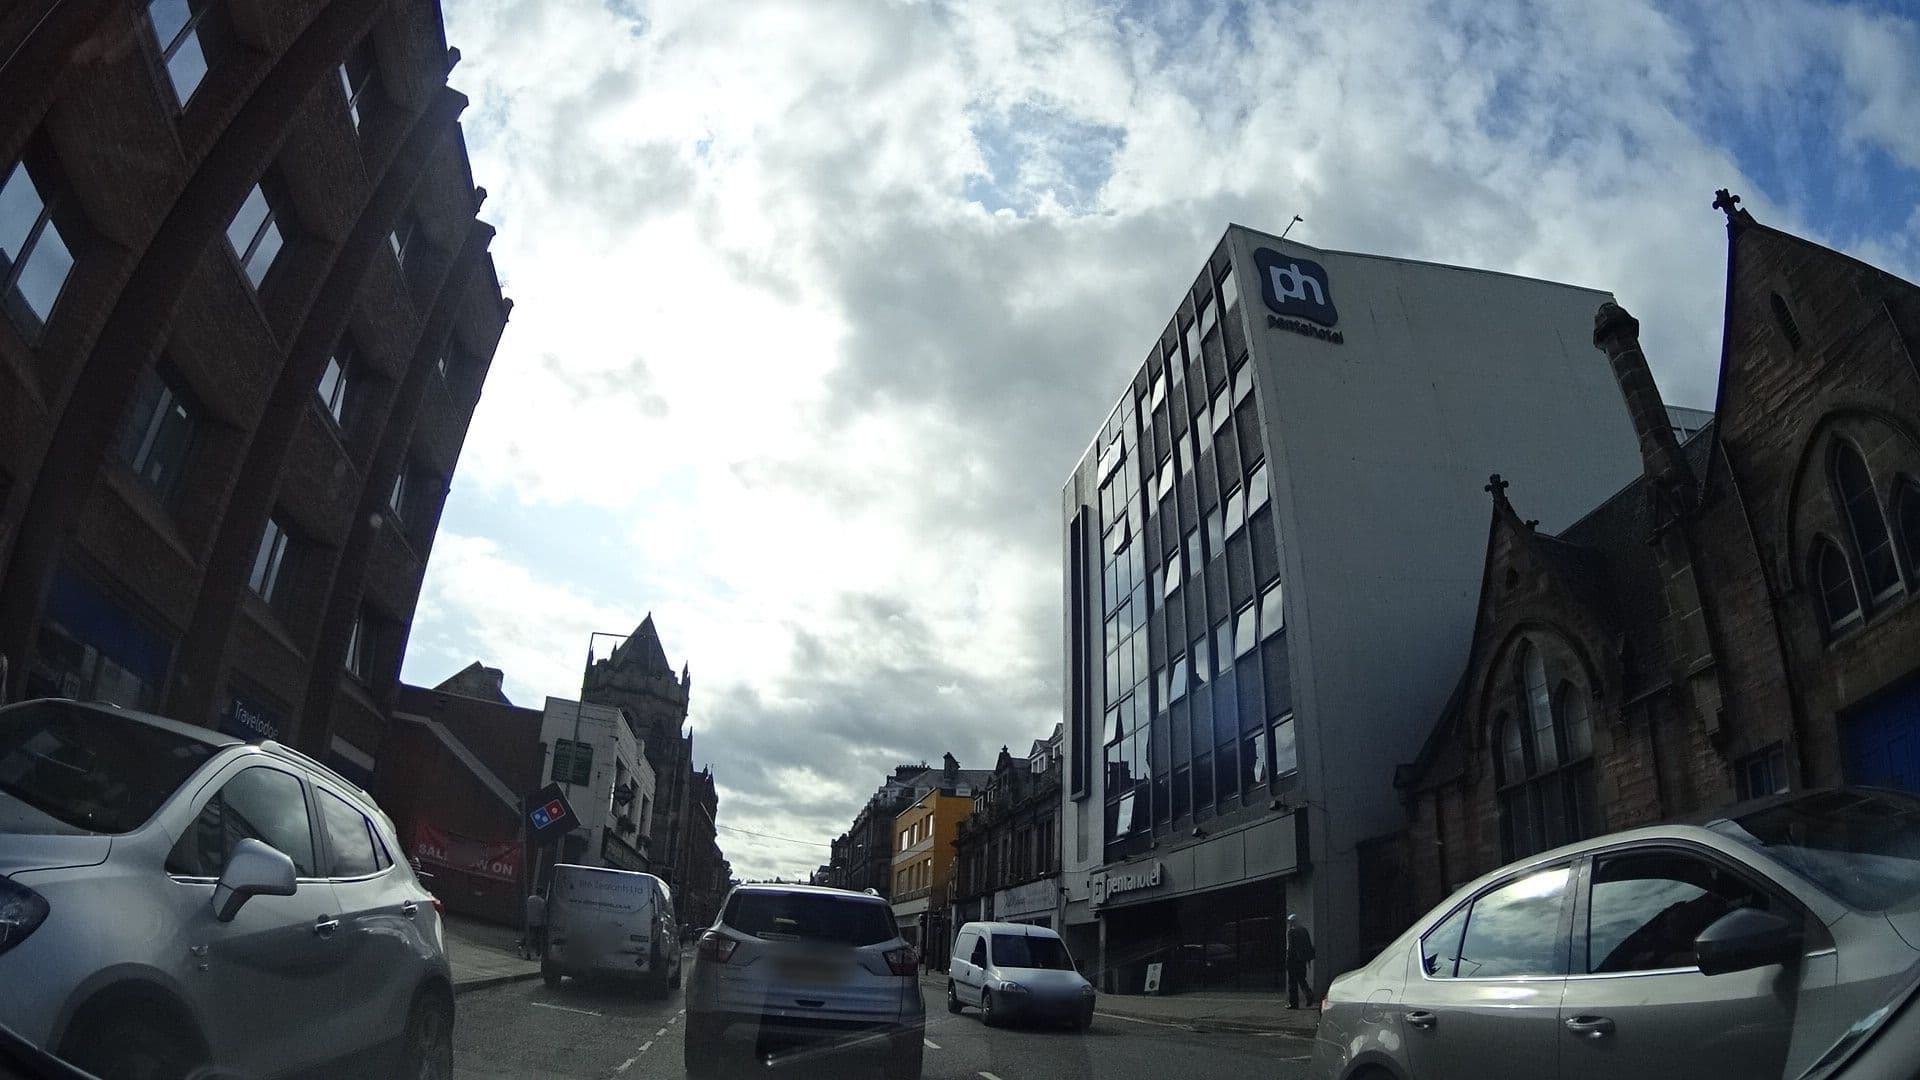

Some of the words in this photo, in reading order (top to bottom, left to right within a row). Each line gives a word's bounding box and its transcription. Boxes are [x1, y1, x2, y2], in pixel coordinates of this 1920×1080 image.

[1269, 263, 1325, 305] ph
[1267, 314, 1344, 344] pentahotel
[418, 844, 448, 862] SAL
[492, 862, 513, 876] ON
